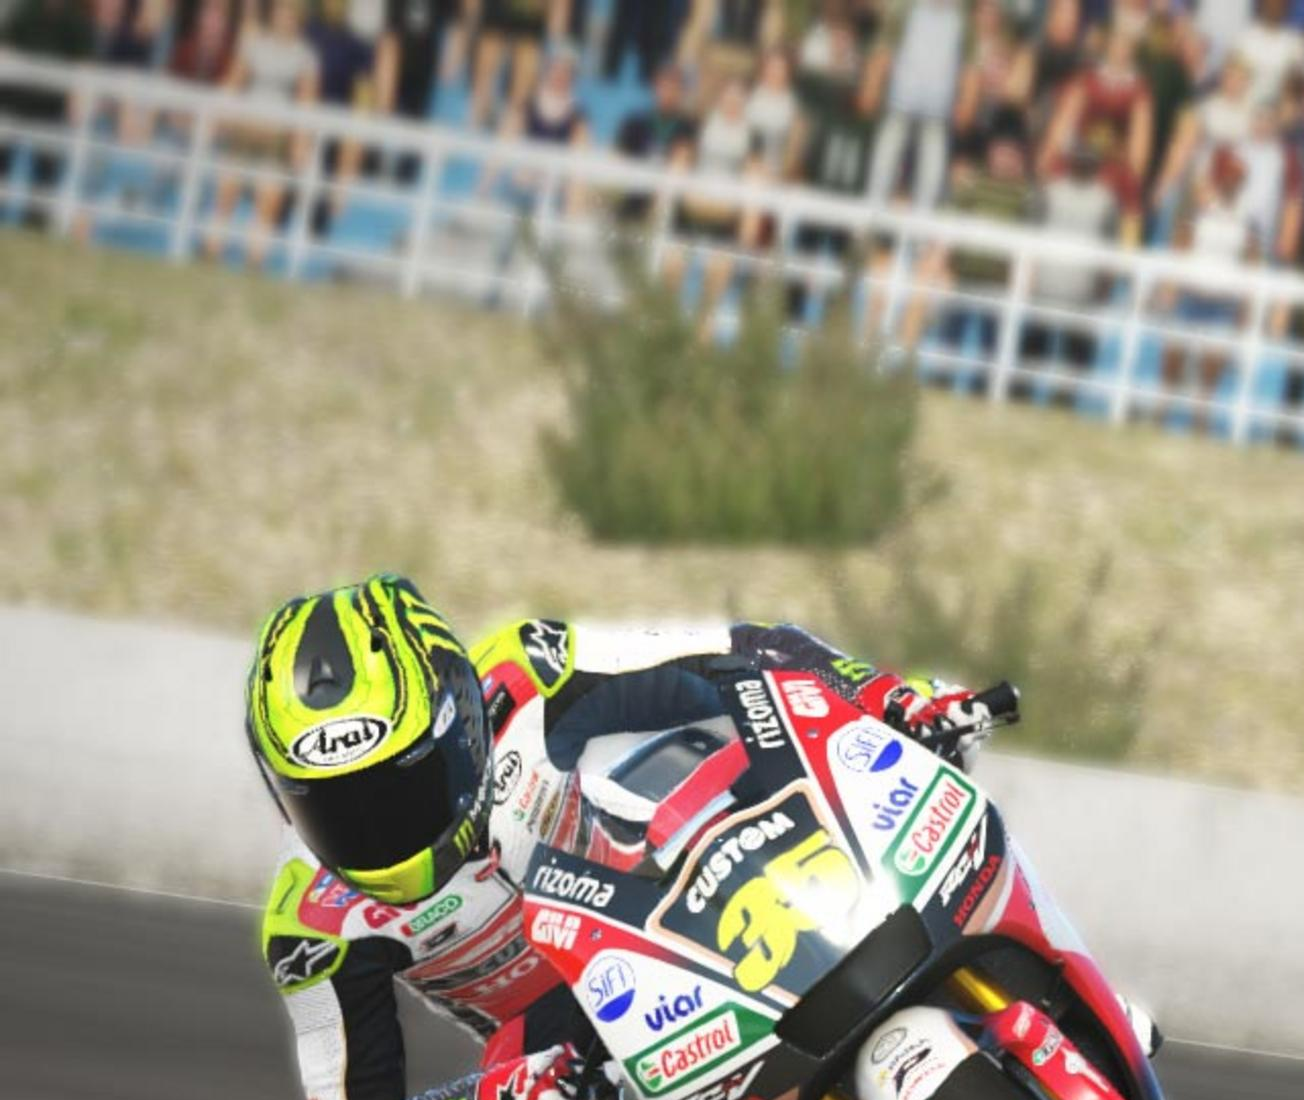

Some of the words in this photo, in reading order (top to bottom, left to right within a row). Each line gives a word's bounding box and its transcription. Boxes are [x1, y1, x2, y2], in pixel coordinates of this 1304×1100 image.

[299, 719, 374, 755] Arai
[735, 680, 785, 748] rizoma
[872, 777, 918, 831] viar
[912, 781, 966, 853] Castrol
[533, 857, 616, 907] rizoma
[686, 812, 795, 913] CUSTOM
[953, 855, 1002, 926] HONDA
[531, 909, 581, 950] GIVI
[644, 985, 702, 1031] viar
[660, 1020, 735, 1079] Castrol
